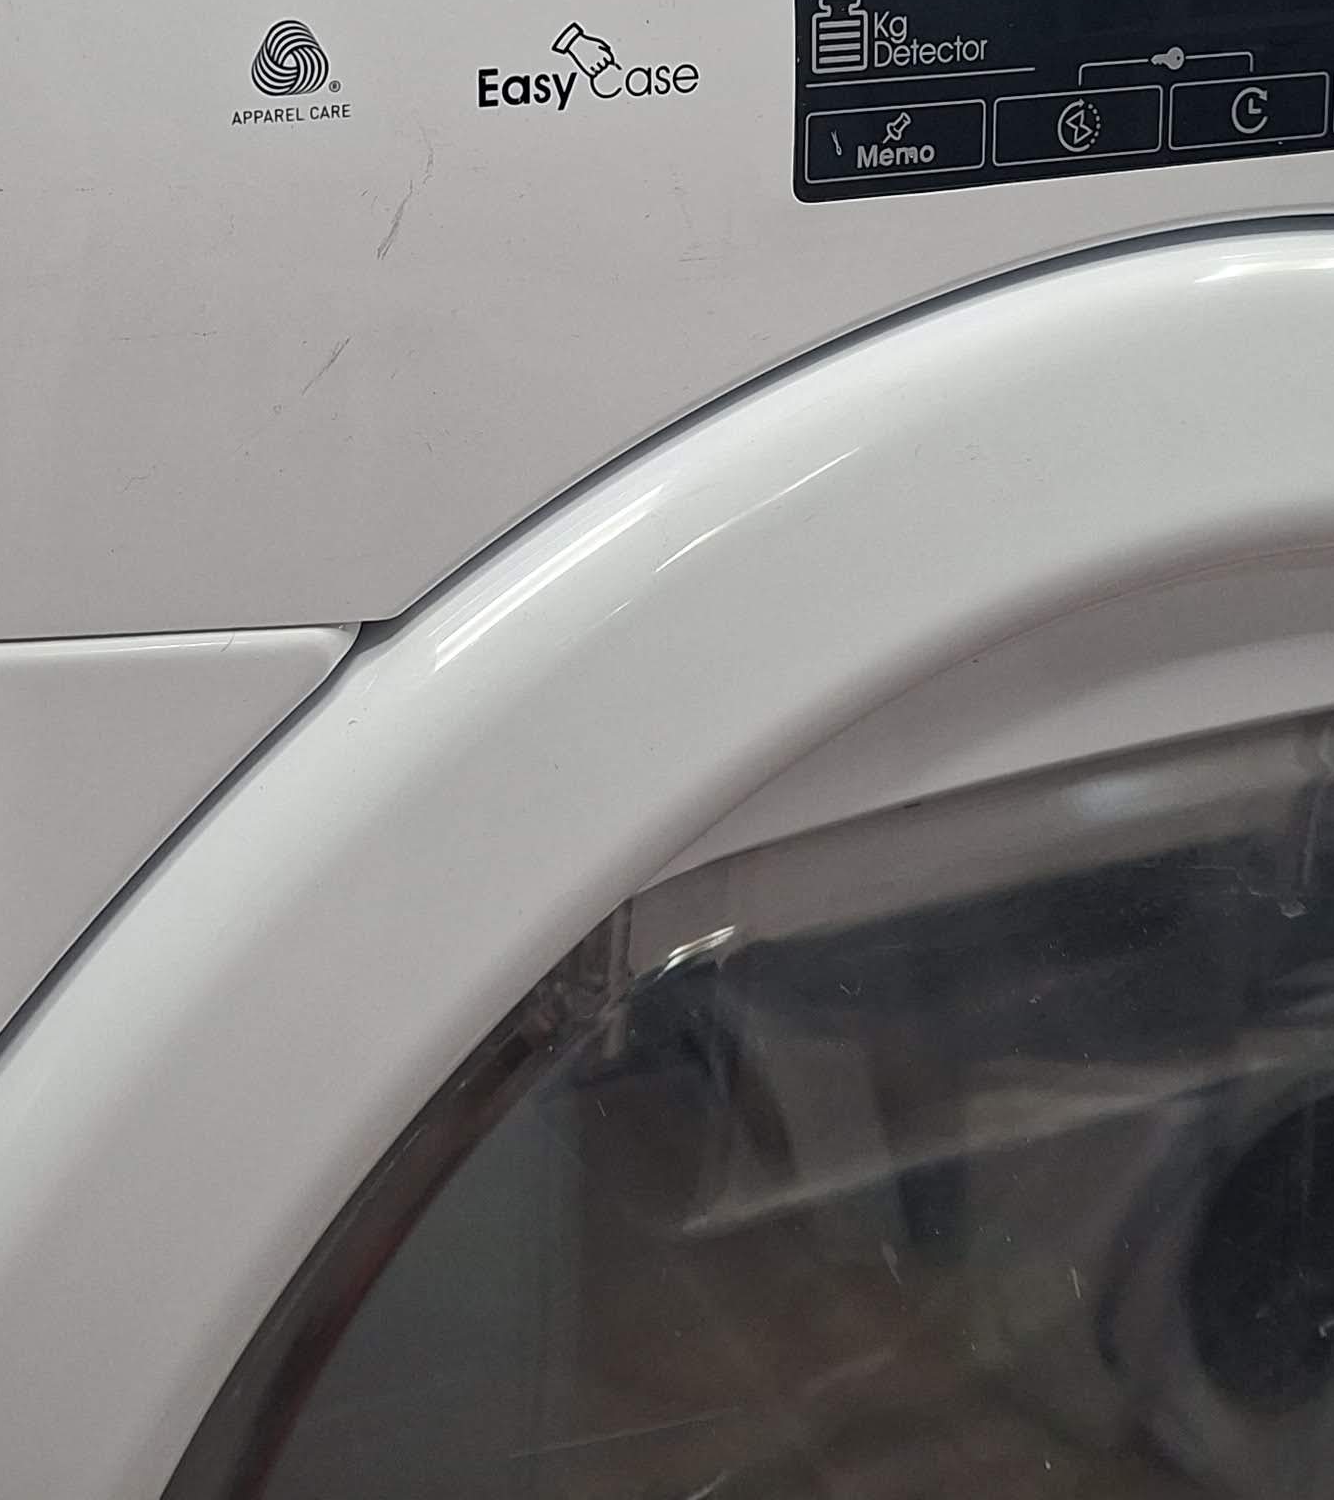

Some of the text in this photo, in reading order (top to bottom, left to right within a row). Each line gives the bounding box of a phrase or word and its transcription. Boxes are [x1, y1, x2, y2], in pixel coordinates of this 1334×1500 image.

[874, 11, 907, 43] Kg
[874, 35, 988, 67] Detector
[232, 103, 351, 126] APPAREL CARE
[857, 144, 935, 168] Memo
